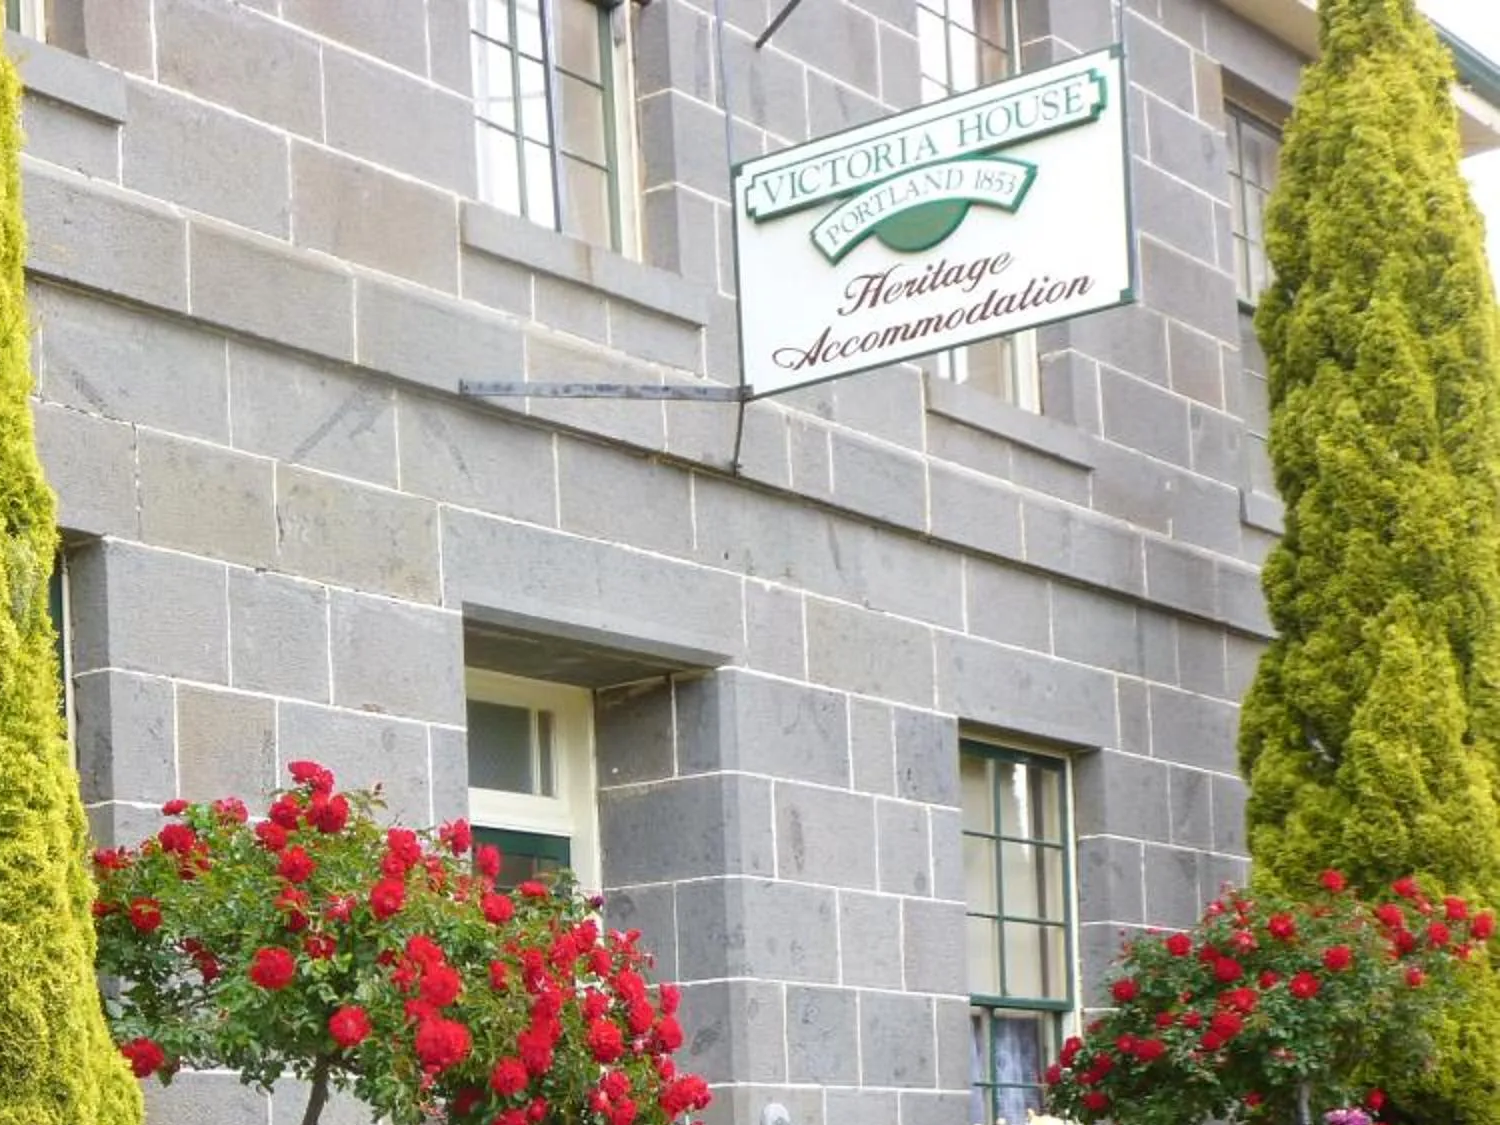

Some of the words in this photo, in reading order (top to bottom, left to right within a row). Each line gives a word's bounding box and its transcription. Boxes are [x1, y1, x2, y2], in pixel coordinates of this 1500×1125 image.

[760, 134, 939, 206] VICTORIA
[957, 81, 1084, 147] HOUSE
[827, 168, 964, 247] PORTLAND
[973, 168, 1018, 195] 1853
[772, 274, 1096, 371] Accommodation
[837, 250, 1013, 318] Heritage
